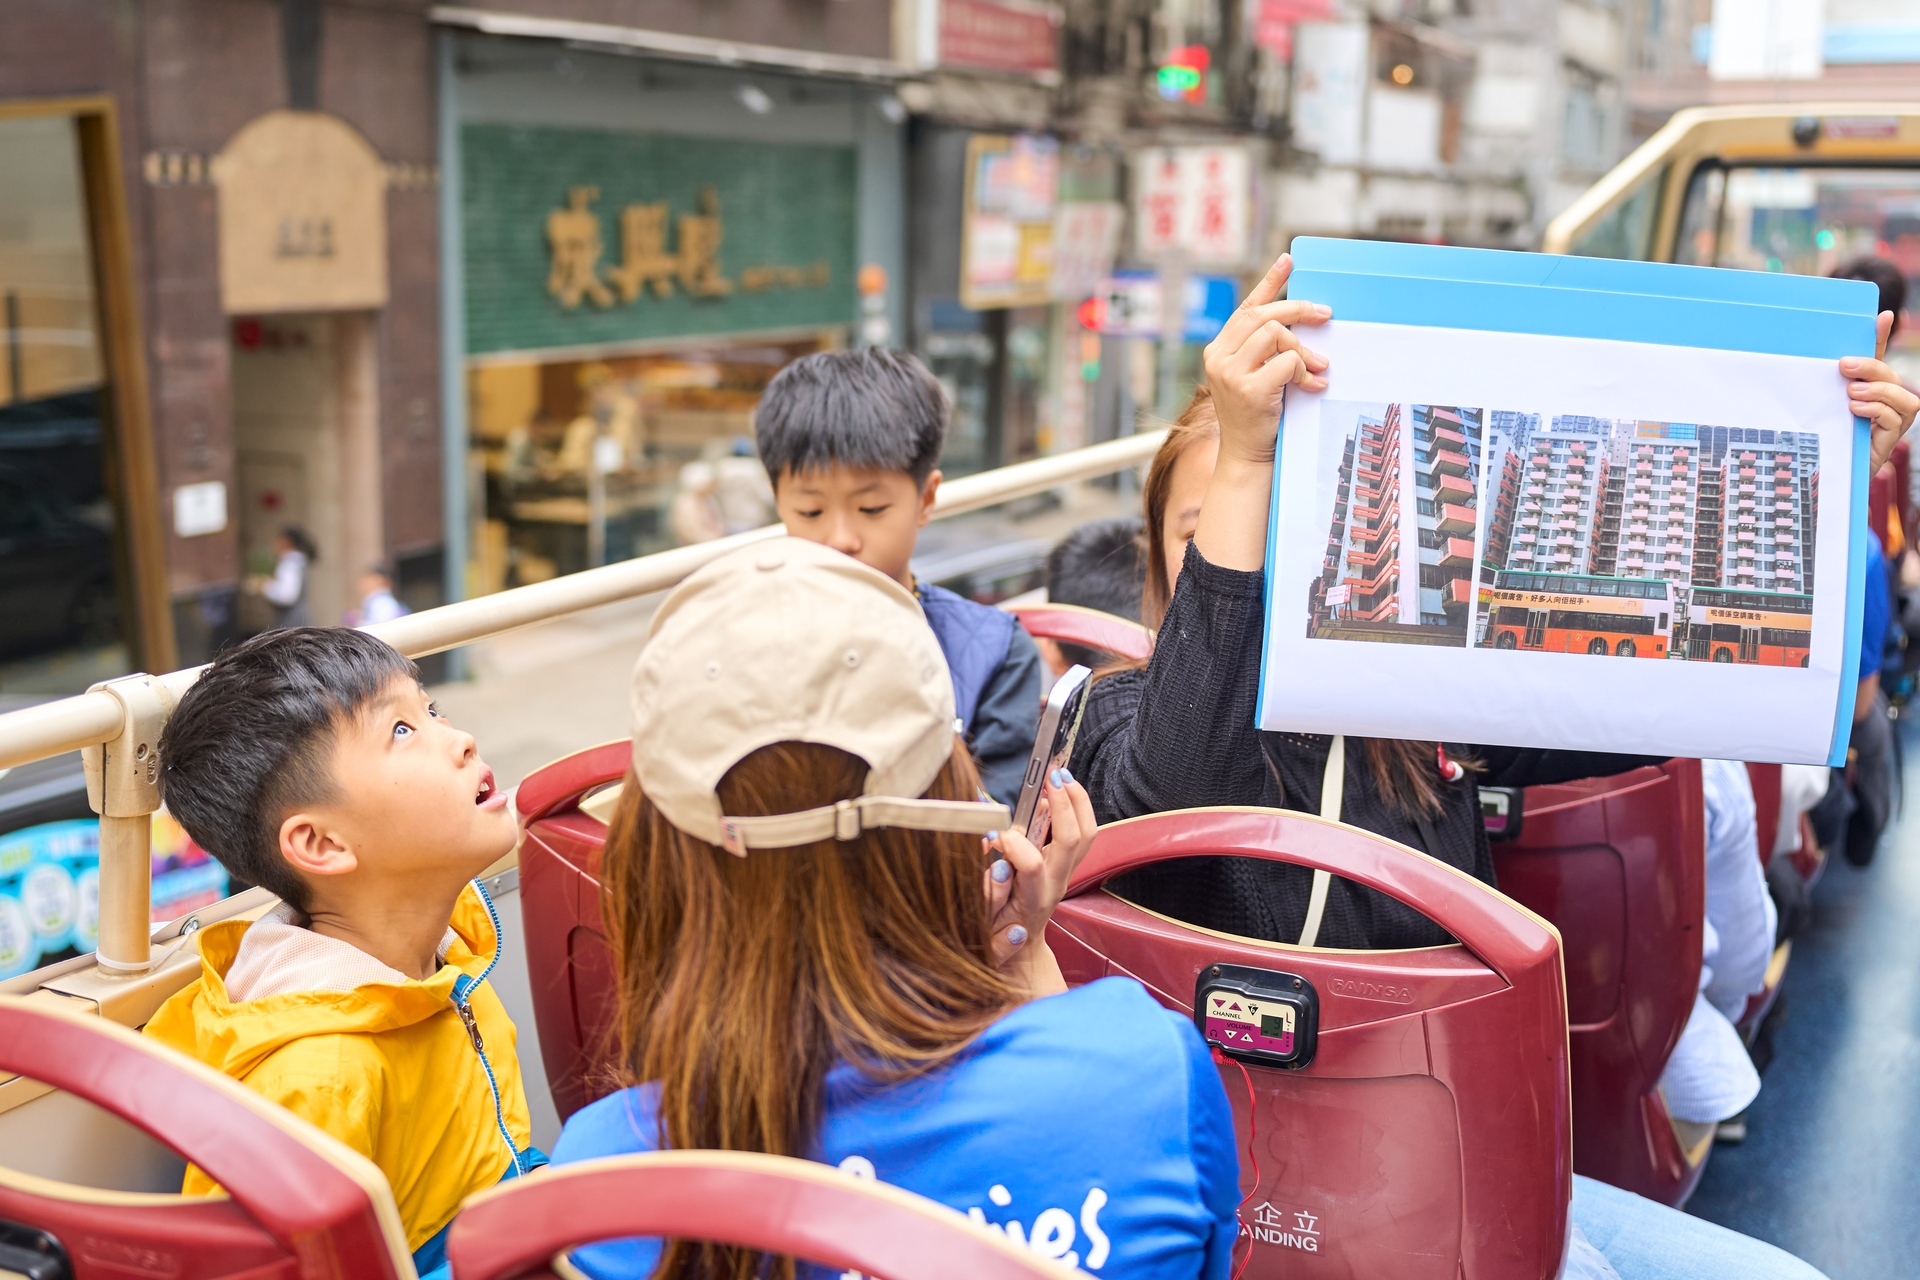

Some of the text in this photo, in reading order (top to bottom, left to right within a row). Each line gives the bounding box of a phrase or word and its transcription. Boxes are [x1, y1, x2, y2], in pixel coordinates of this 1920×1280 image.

[1212, 1010, 1241, 1020] CHANNEL
[1226, 1022, 1253, 1031] VOLUME
[1237, 1201, 1320, 1235] 企立
[1238, 1223, 1318, 1252] ANDING
